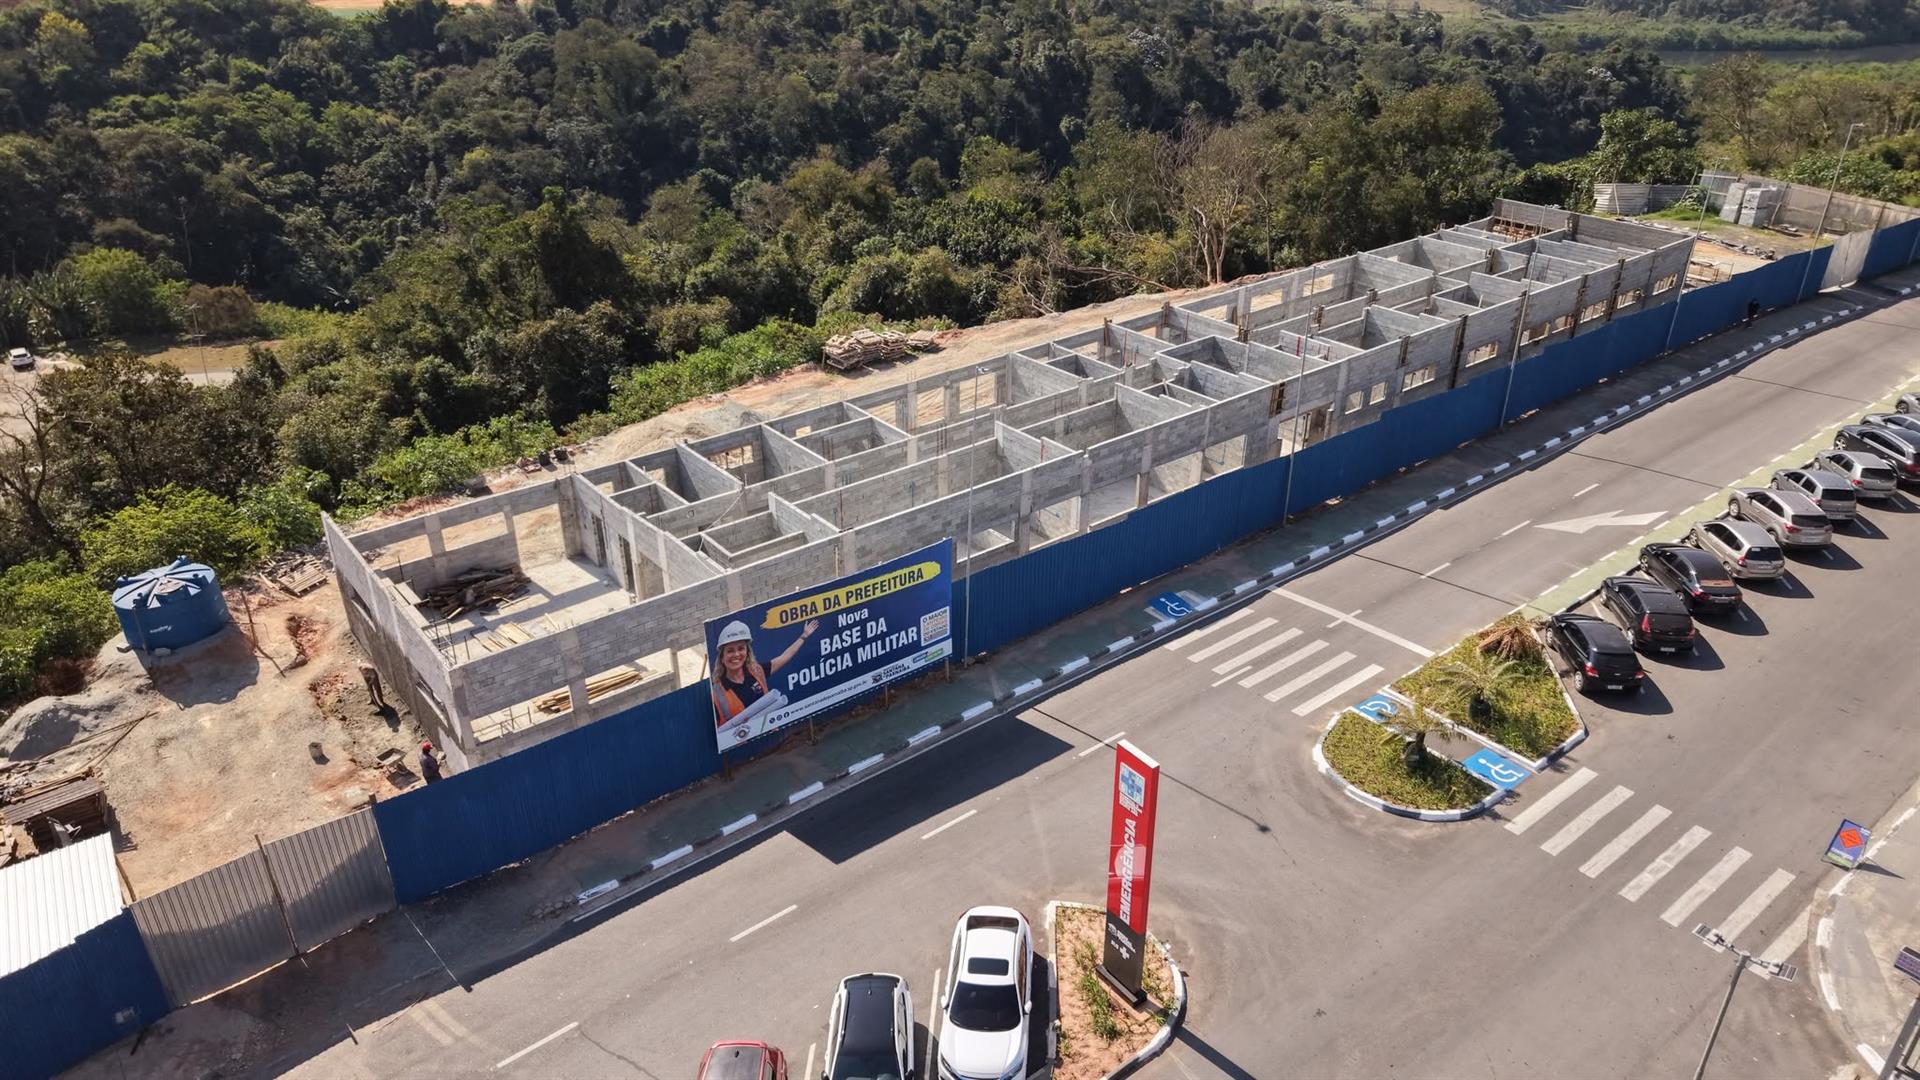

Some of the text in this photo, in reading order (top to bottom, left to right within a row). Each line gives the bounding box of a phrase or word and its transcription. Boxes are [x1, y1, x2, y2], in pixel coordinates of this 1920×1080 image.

[780, 568, 924, 624] OBRA DA PREFEITURA
[838, 608, 869, 627] Nova
[788, 653, 853, 691] POLÍCIA
[857, 626, 918, 664] MILITAR
[820, 617, 887, 656] BASE DA
[1119, 818, 1136, 926] EMERGÊNCIA
